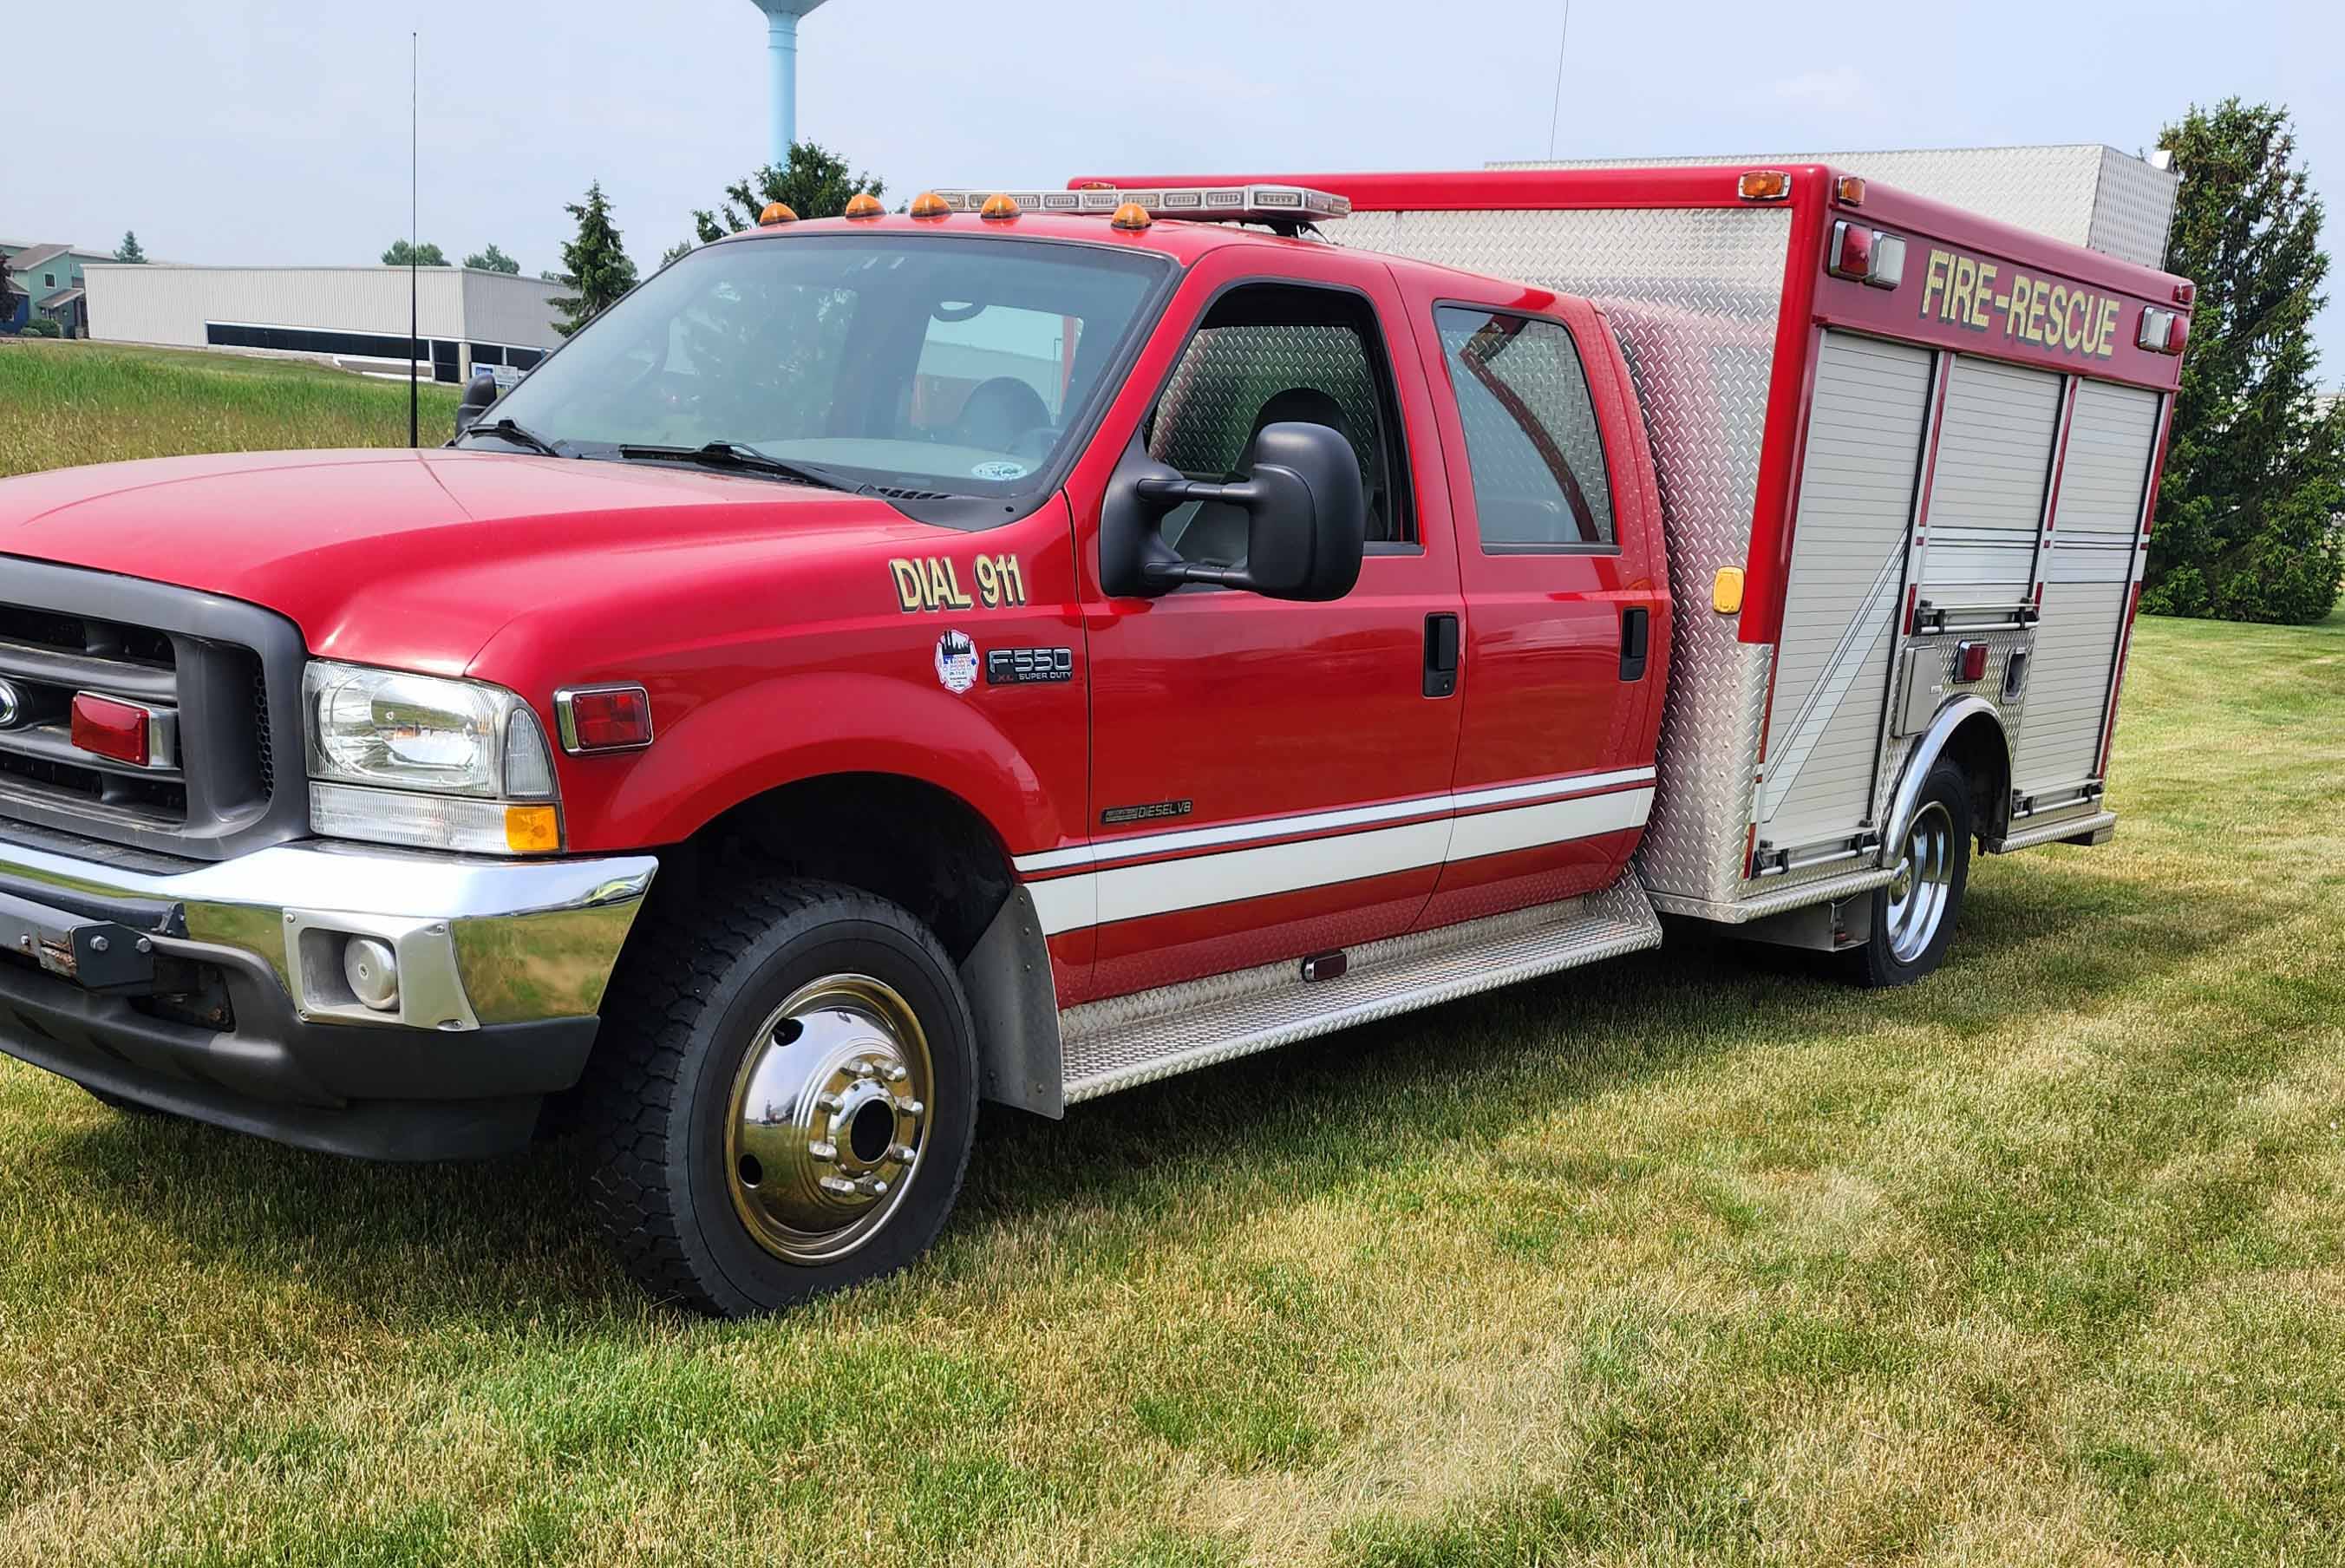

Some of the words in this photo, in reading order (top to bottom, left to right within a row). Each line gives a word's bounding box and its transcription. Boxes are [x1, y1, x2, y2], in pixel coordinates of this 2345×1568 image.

[1919, 249, 2120, 360] FIRE-RESCUE
[889, 557, 973, 612] DIAL
[974, 554, 1026, 609] 911
[1018, 672, 1048, 681] SUPER
[1138, 803, 1176, 818] DIESEL
[1178, 801, 1192, 813] V8
